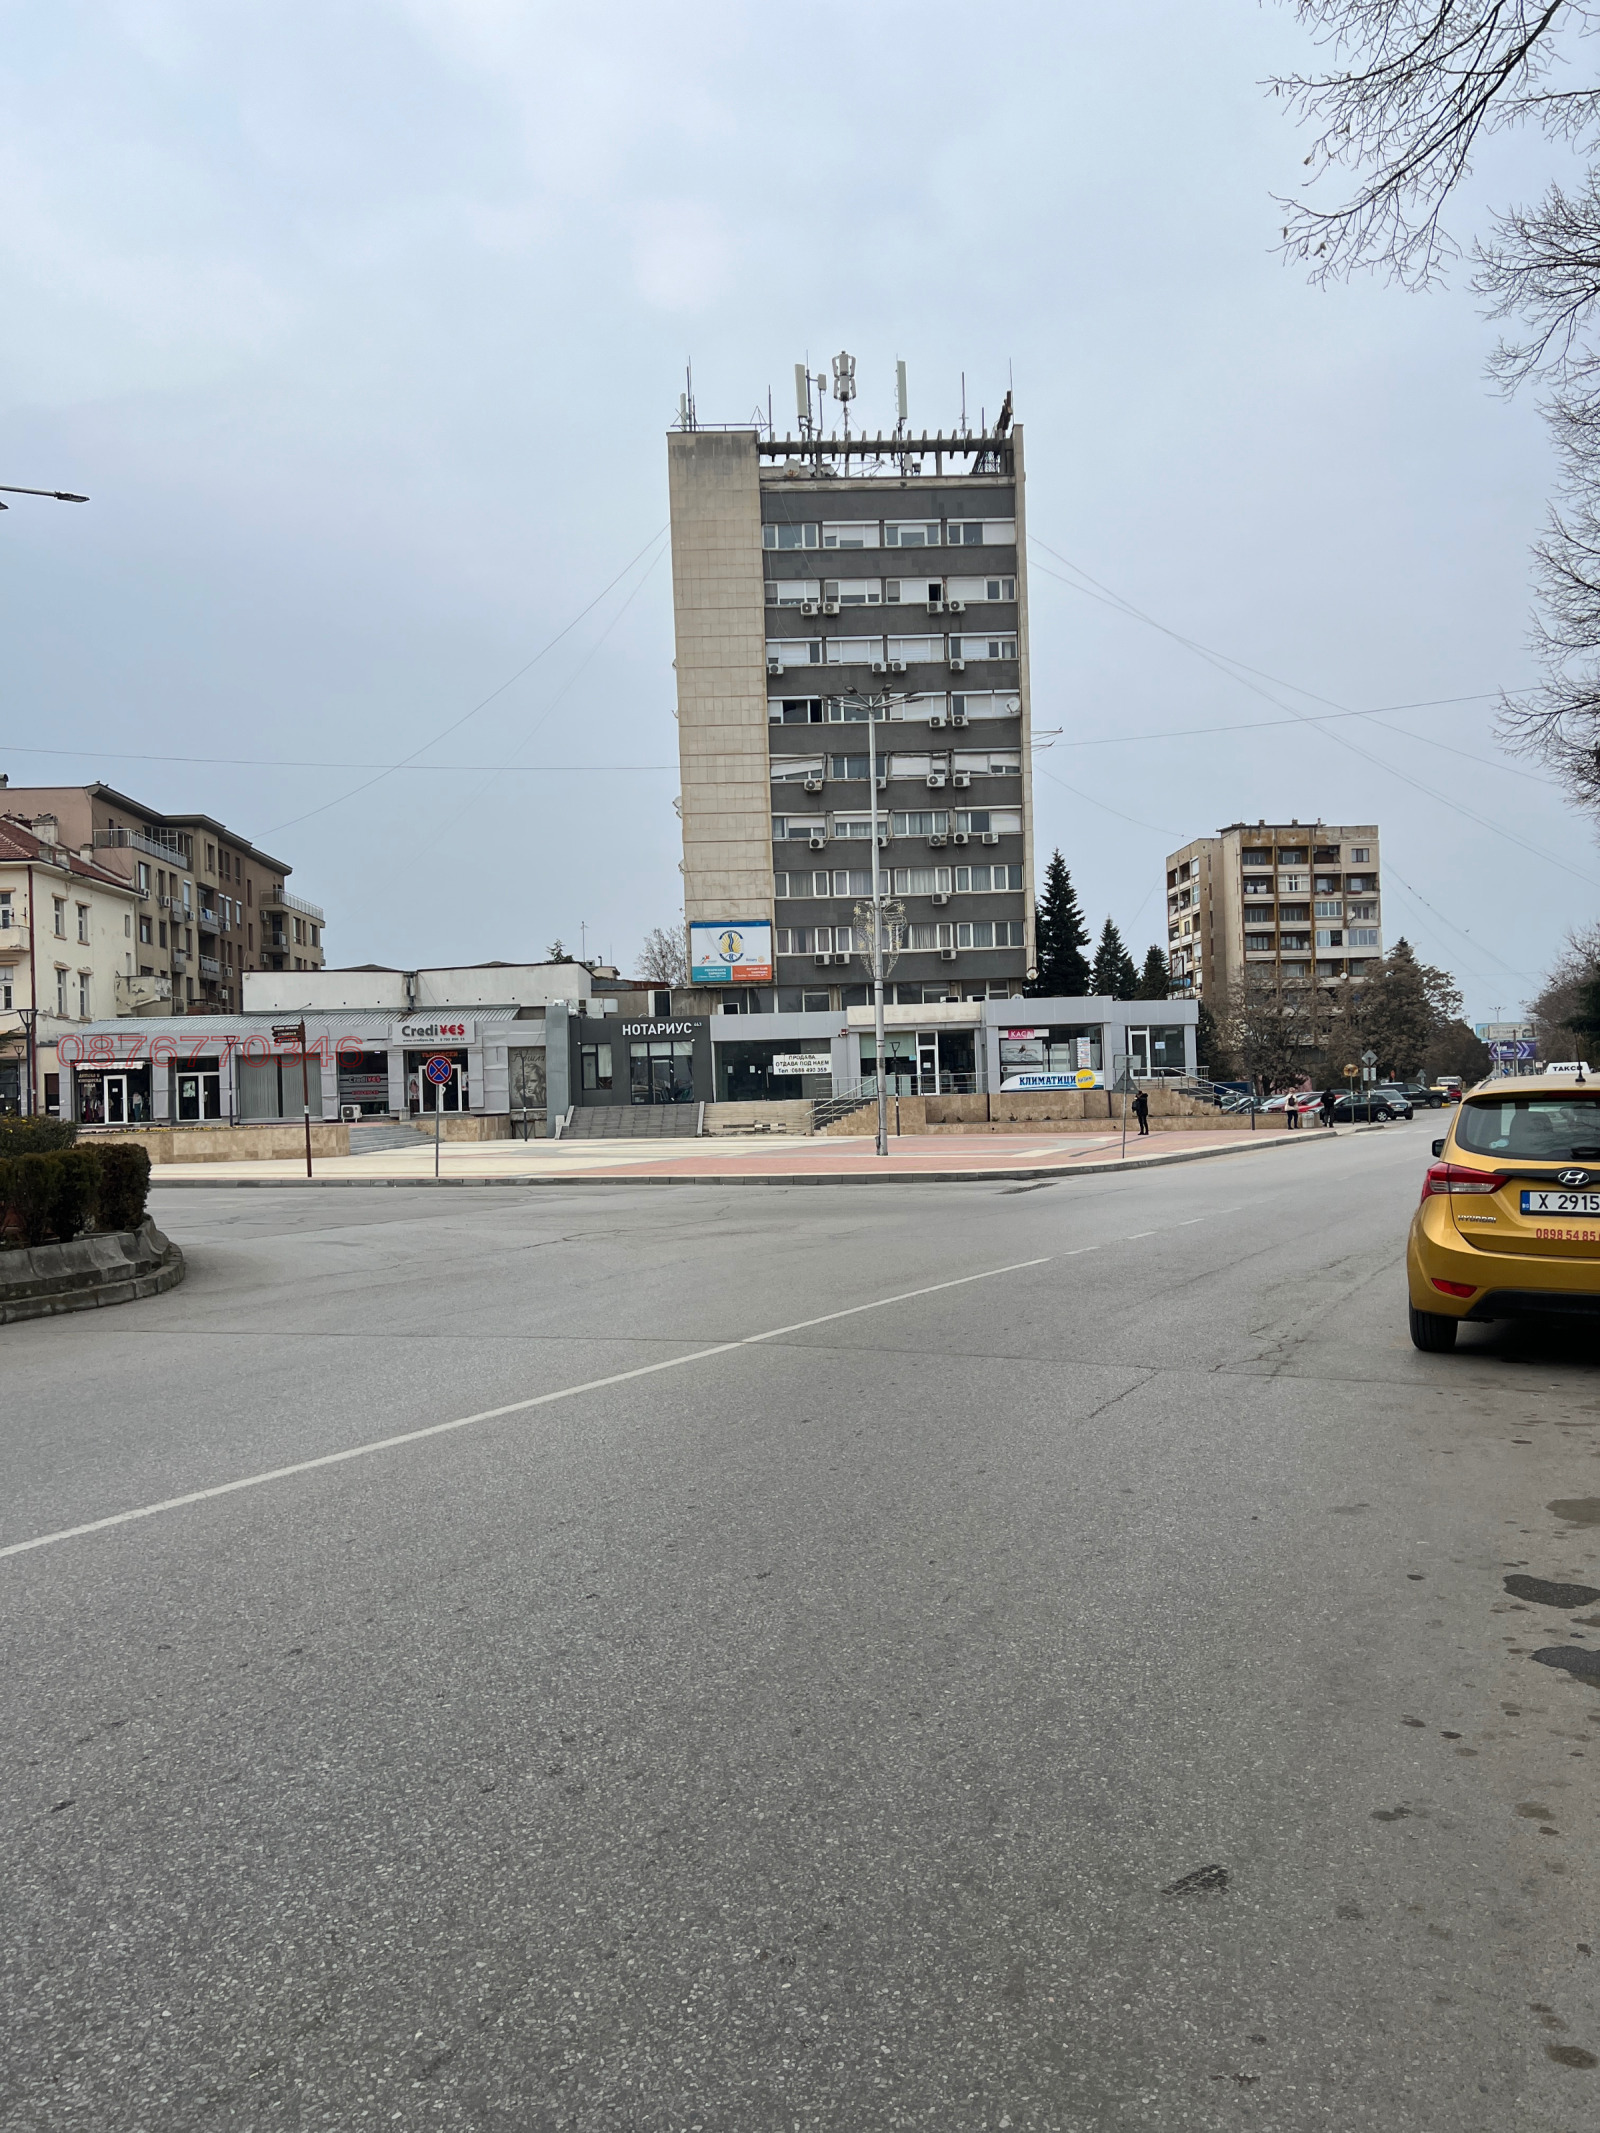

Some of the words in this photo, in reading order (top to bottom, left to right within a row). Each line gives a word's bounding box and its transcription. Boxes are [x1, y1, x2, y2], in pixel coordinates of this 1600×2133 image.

[622, 1022, 692, 1036] НОТАРИУС
[1019, 1075, 1077, 1086] КЛИМАТИЦИ
[1457, 1214, 1497, 1224] HYUNDAI
[1535, 1228, 1563, 1240] 0898
[1565, 1229, 1580, 1241] 54
[1582, 1230, 1596, 1242] 85
